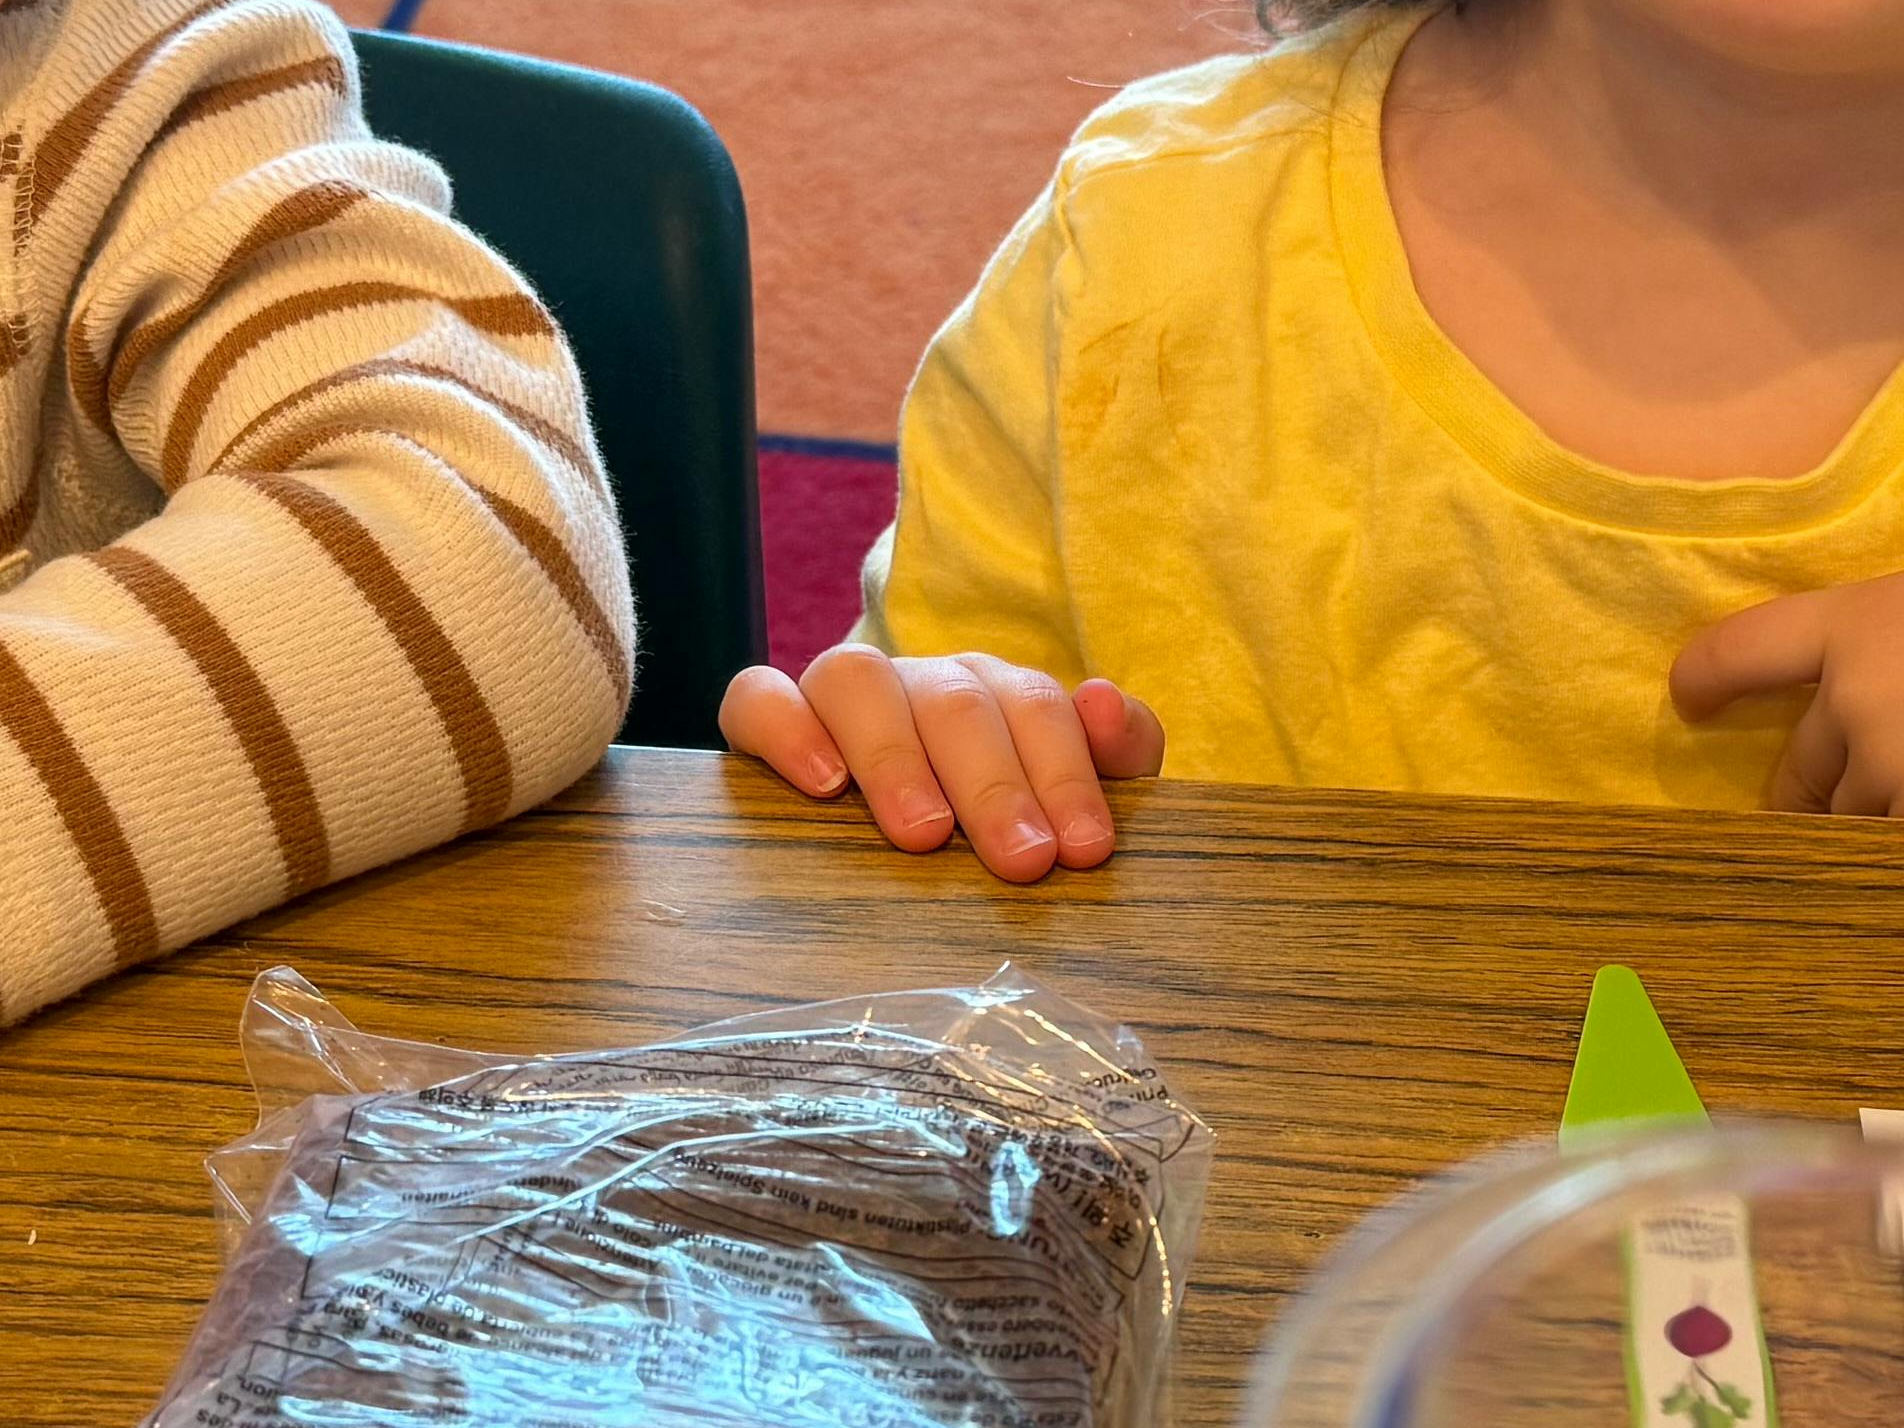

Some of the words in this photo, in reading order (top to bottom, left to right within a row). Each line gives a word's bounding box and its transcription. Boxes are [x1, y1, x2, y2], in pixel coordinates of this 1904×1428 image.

[769, 1184, 813, 1212] kein
[816, 1198, 860, 1224] sind
[216, 1391, 241, 1416] La
